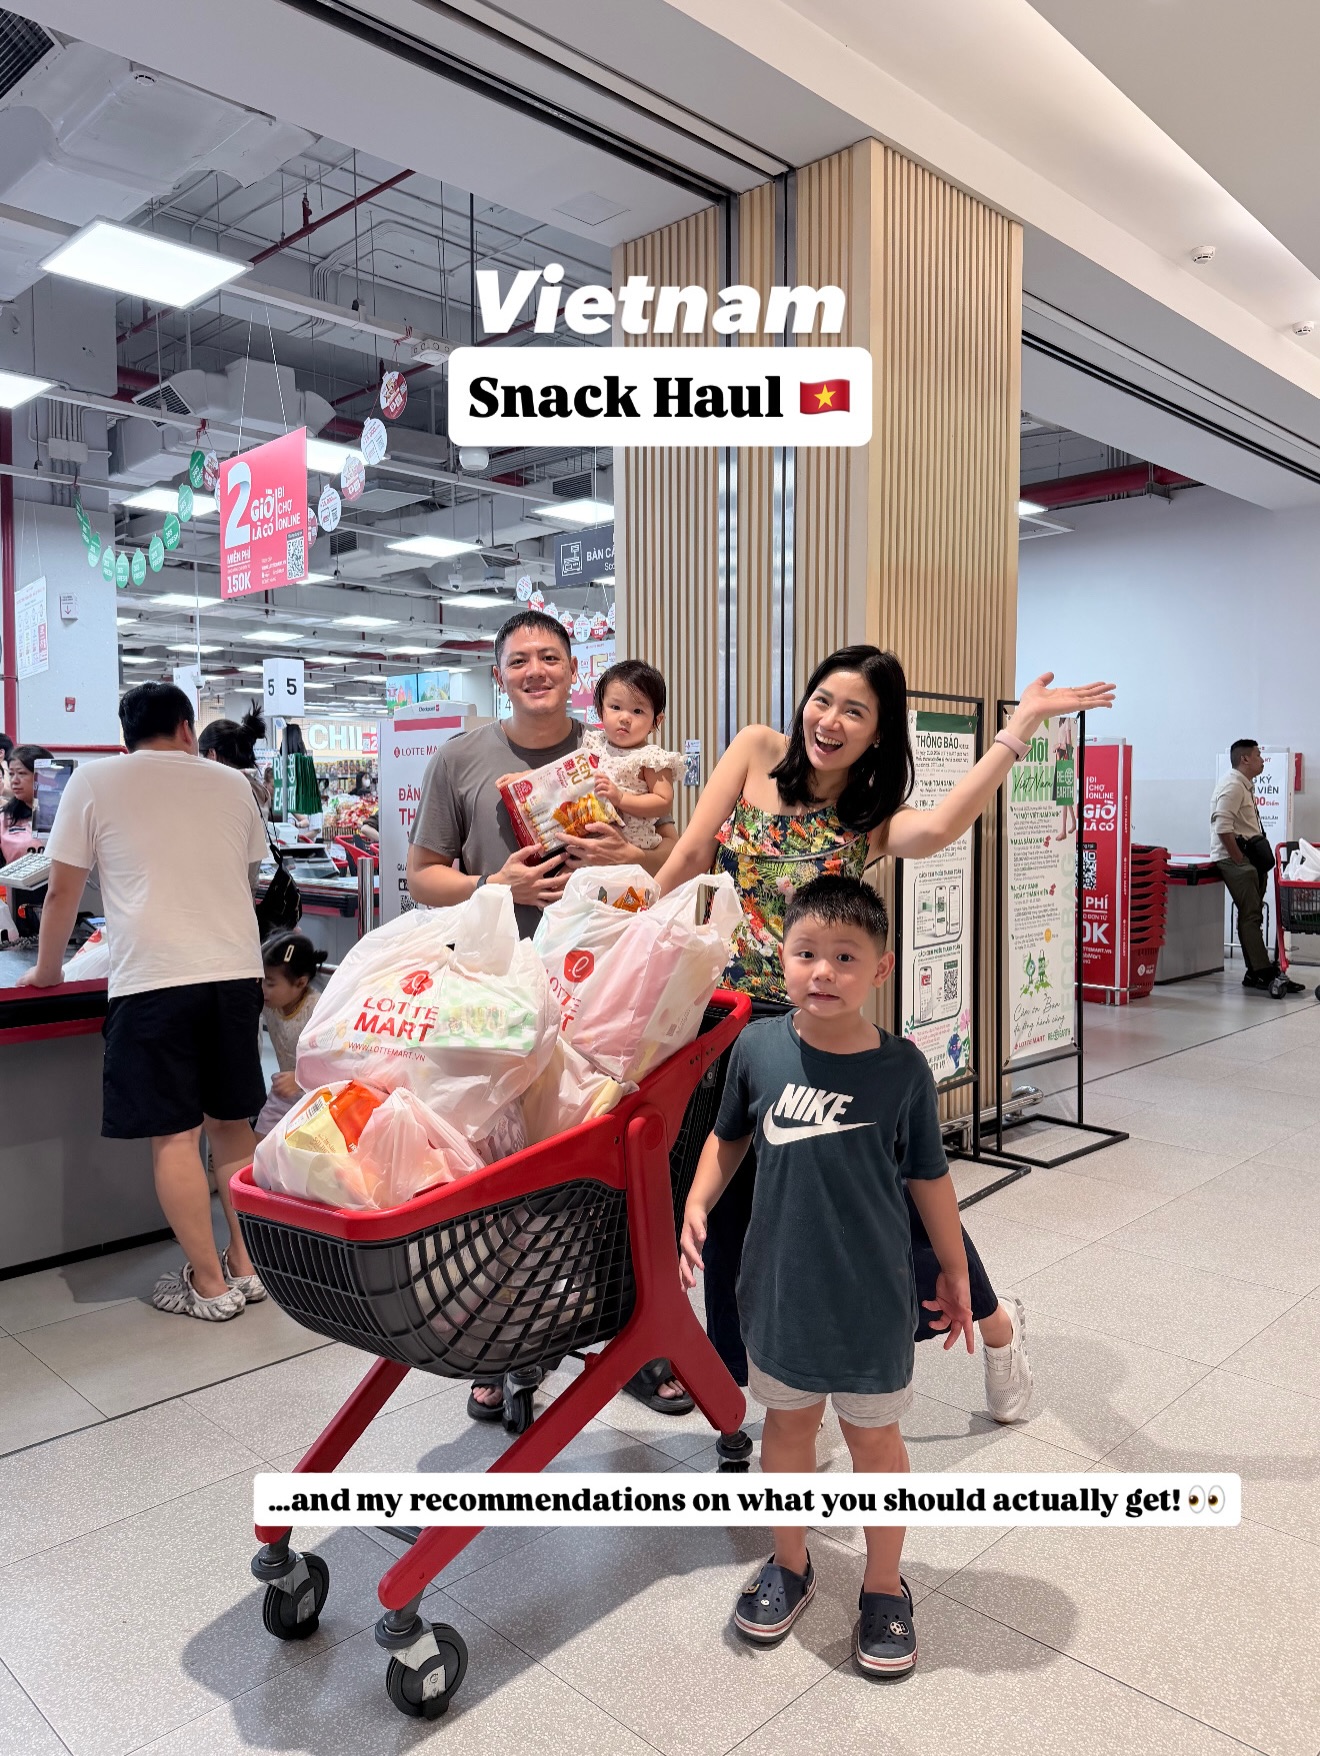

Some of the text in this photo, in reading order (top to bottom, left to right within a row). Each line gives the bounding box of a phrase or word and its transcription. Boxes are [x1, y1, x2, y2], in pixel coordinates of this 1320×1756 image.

[225, 461, 251, 549] 2
[278, 512, 301, 531] ONLINE
[586, 547, 604, 562] BÀN
[227, 571, 252, 594] 150K
[268, 678, 275, 696] 5
[286, 678, 297, 696] 5
[308, 723, 377, 752] CHIL
[916, 732, 942, 749] THÔNG
[944, 733, 959, 749] BÁO
[401, 745, 438, 757] LOTTE MA
[575, 753, 593, 780] KEN
[567, 769, 583, 785] JU
[1259, 774, 1272, 784] KÝ
[398, 784, 421, 801] ĐĂN
[1089, 784, 1105, 793] CHỢ
[1089, 792, 1114, 800] ONLINE
[1257, 786, 1279, 795] VIÊN
[1098, 818, 1115, 832] CÓ
[1085, 894, 1109, 910] PHÍ
[1061, 939, 1074, 1012] ECO
[363, 995, 440, 1022] LOTTE
[353, 1012, 435, 1043] MART
[1032, 1035, 1045, 1044] MART
[348, 1041, 426, 1063] WWW.LOTTEMART.VN
[774, 1083, 854, 1126] NIKE
